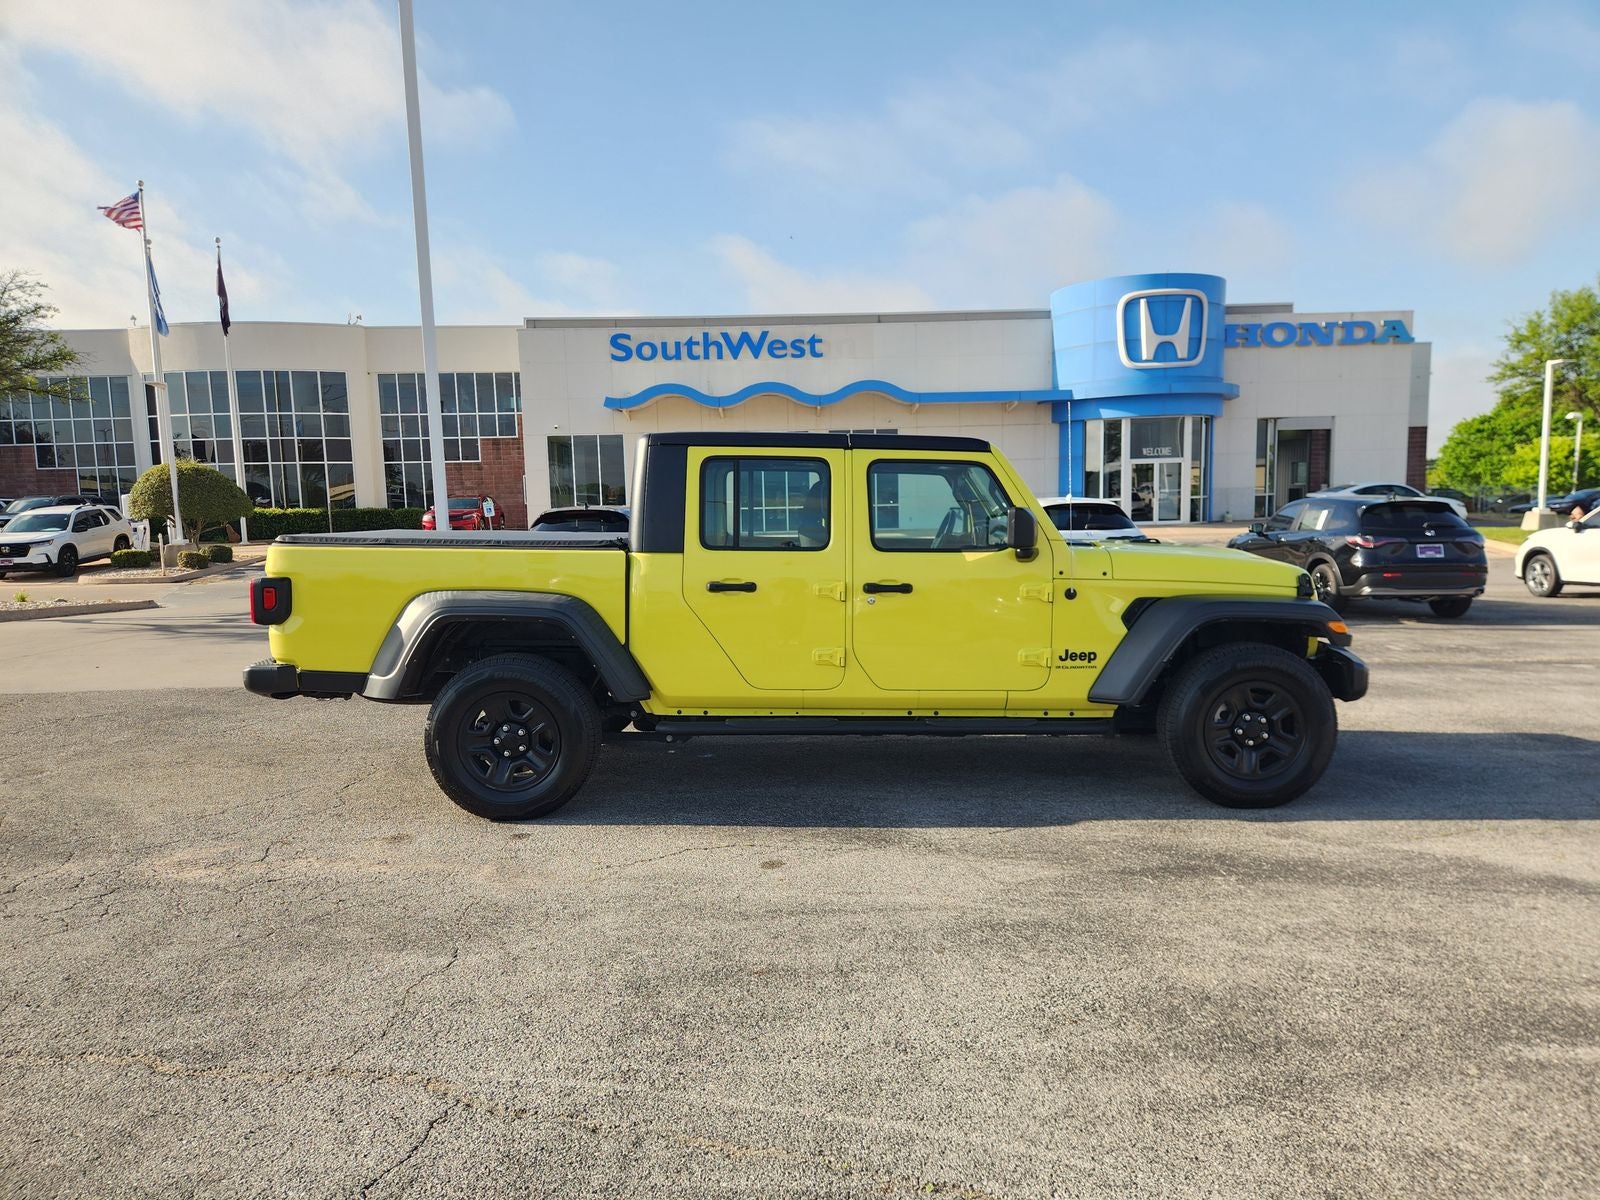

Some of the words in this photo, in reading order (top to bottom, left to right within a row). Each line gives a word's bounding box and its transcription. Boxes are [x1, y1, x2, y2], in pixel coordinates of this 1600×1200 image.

[1224, 320, 1415, 348] HONDA
[609, 330, 824, 362] SouthWest
[1142, 446, 1172, 456] WELCOME
[1059, 649, 1097, 663] Jeep
